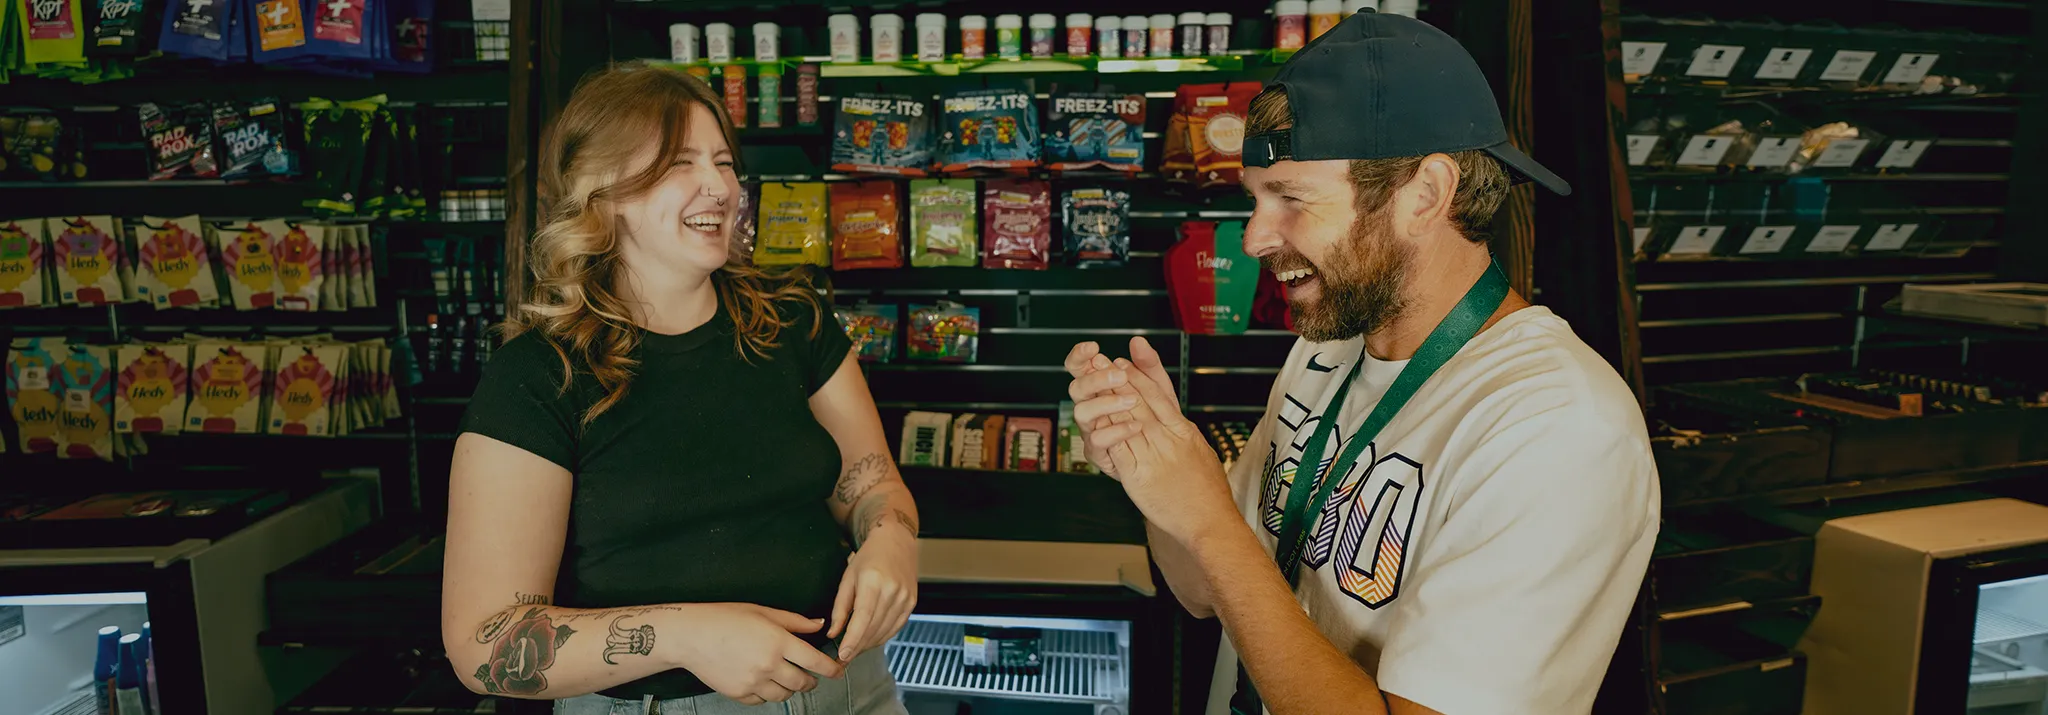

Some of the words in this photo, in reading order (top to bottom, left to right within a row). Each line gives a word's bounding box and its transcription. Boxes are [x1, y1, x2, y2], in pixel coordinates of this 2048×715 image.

[1055, 97, 1141, 116] FREEZ-ITS
[151, 125, 187, 148] RAD
[223, 122, 260, 146] RAD
[232, 130, 269, 158] ROX
[160, 134, 196, 159] ROX
[132, 385, 166, 399] Hedy
[206, 386, 242, 399] Hedy
[287, 391, 316, 405] Hedy
